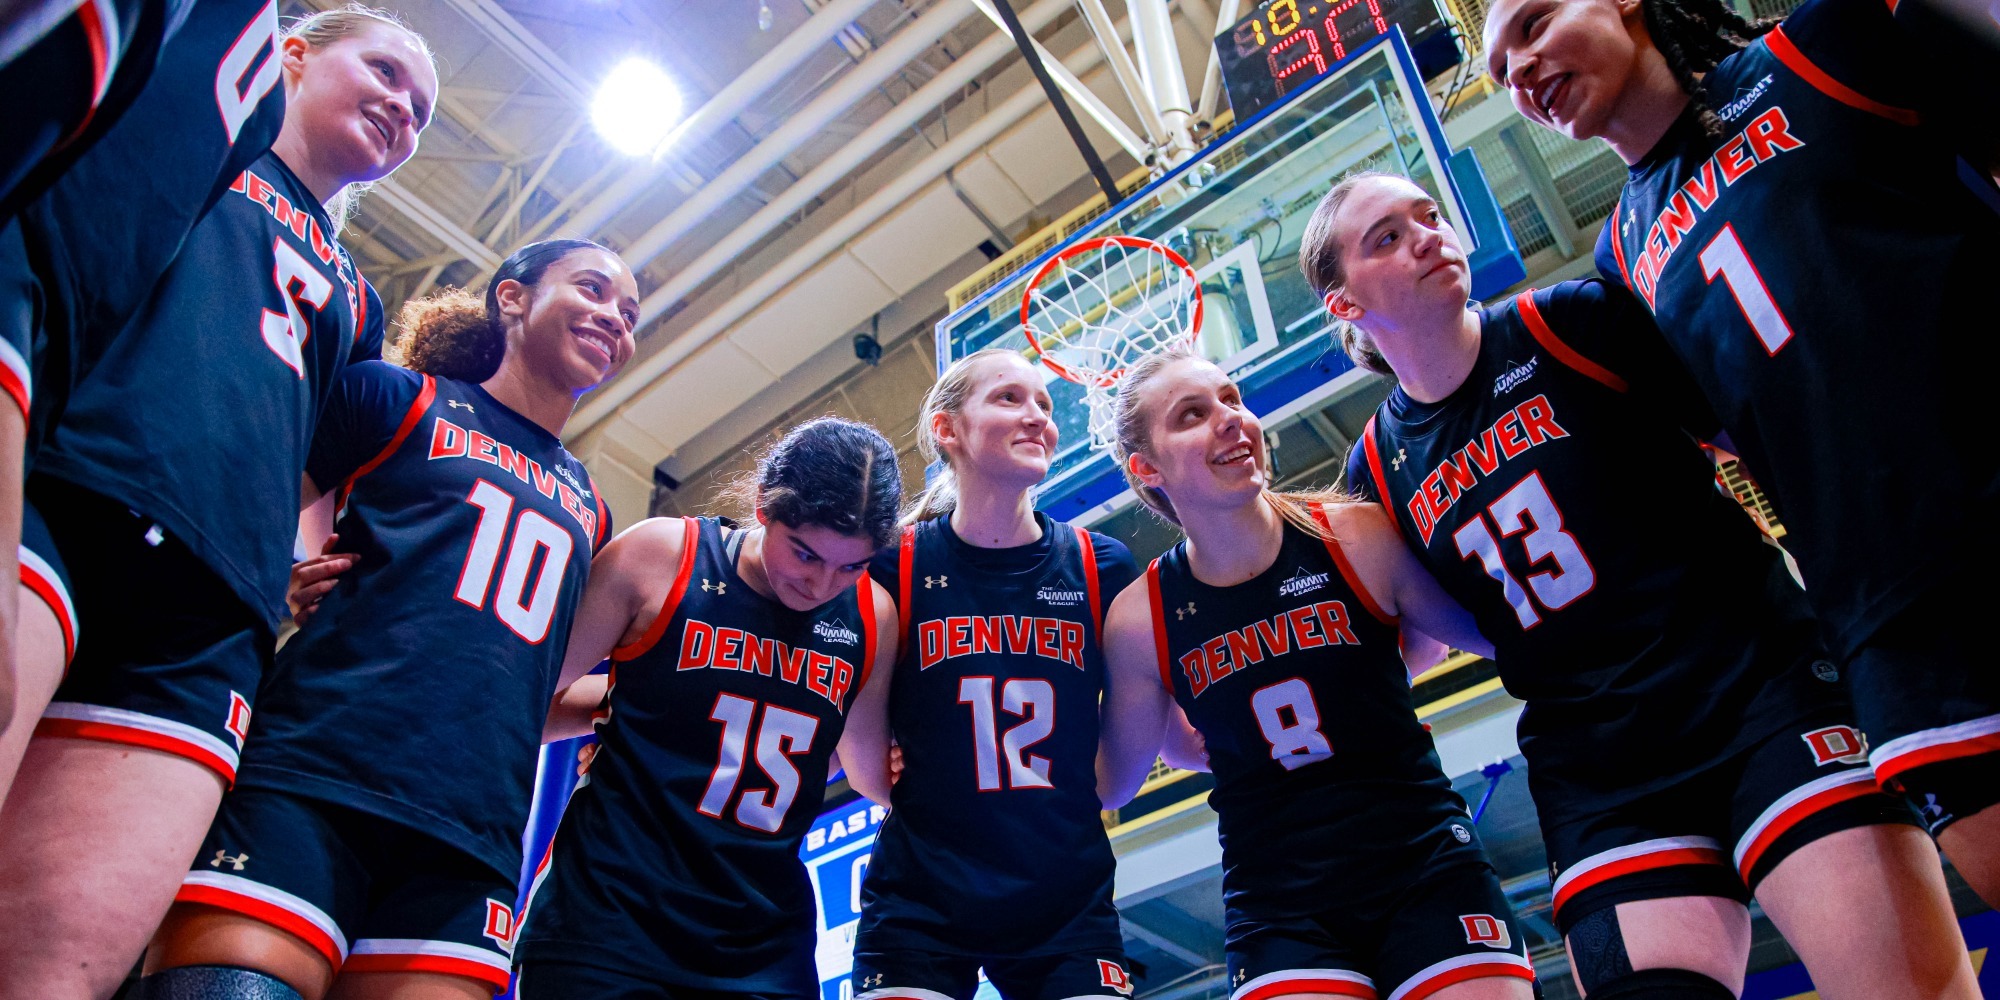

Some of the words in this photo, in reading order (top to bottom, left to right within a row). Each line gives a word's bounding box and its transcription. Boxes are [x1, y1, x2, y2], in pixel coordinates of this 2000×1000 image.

[1718, 73, 1773, 120] UMMIT
[1633, 105, 1806, 316] DENVER
[259, 235, 334, 380] 5
[1697, 221, 1795, 357] 1
[1493, 355, 1537, 398] SUMMIT
[428, 416, 597, 557] DENVER
[1407, 394, 1571, 549] DENVER
[453, 477, 574, 646] 10
[1036, 590, 1084, 601] SUMMIT
[1279, 572, 1329, 596] SUMMIT
[1293, 584, 1322, 597] LEAGUE
[1452, 469, 1597, 631] 13
[677, 618, 854, 716] DENVER
[813, 624, 858, 644] SUMMIT
[823, 638, 851, 646] LEAGUE
[918, 615, 1085, 671] DENVER
[1178, 600, 1361, 699] DENVER
[696, 691, 820, 834] 15
[957, 675, 1056, 792] 12
[1250, 675, 1334, 772] 8
